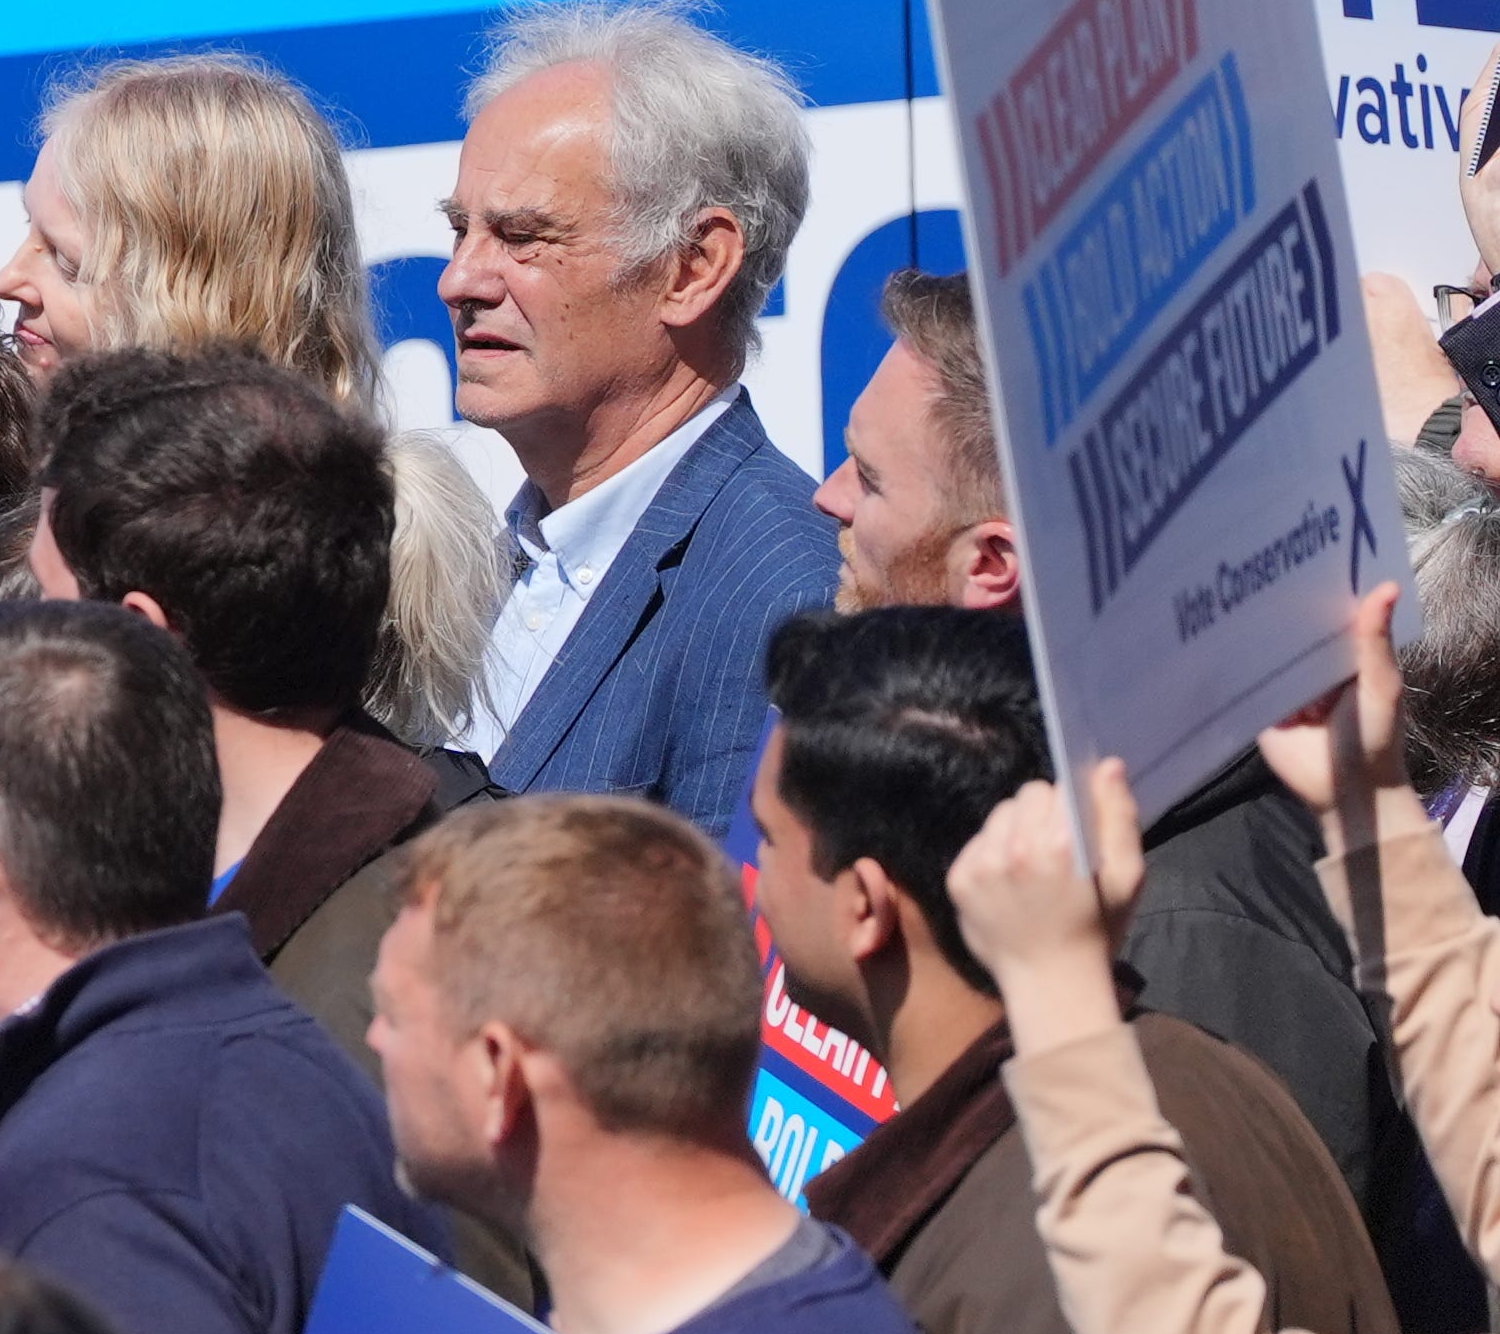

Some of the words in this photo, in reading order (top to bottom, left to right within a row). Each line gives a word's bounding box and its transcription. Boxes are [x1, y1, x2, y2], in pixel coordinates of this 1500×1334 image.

[1020, 24, 1098, 207] CLEAR
[1065, 204, 1136, 366] BOLD
[1132, 92, 1233, 299] ACTION
[1111, 333, 1213, 541] SECURE
[1200, 226, 1316, 437] FUTURE
[1173, 577, 1216, 644] Vote
[1215, 501, 1342, 614] Conservative
